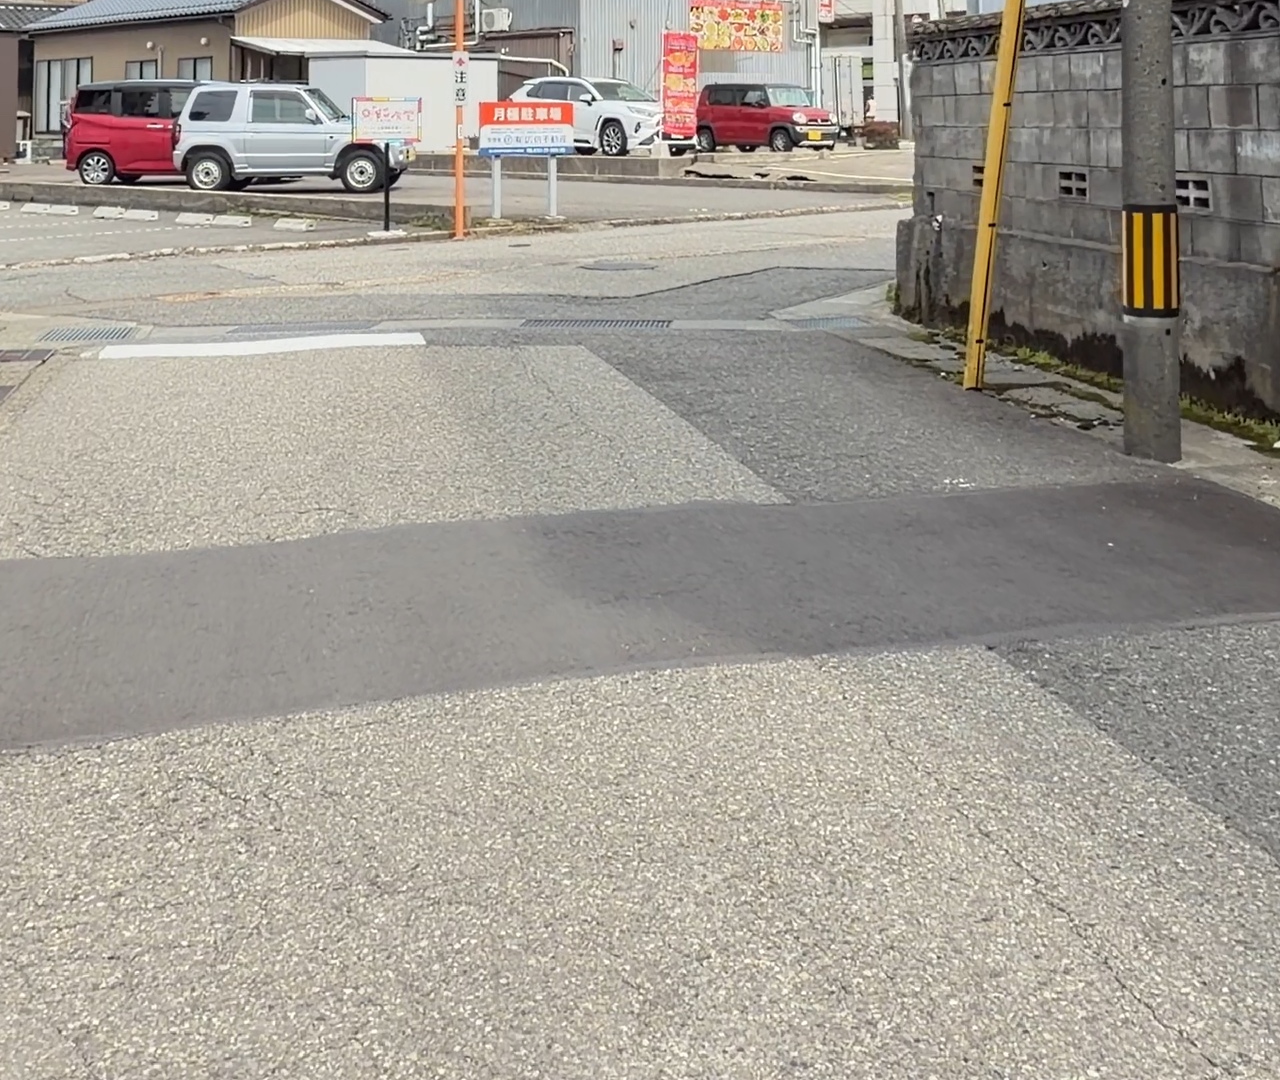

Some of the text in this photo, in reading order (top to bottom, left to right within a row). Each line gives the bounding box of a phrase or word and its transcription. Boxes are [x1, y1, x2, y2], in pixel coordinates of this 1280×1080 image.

[455, 71, 467, 101] 注意
[493, 107, 562, 121] 月極駐車場
